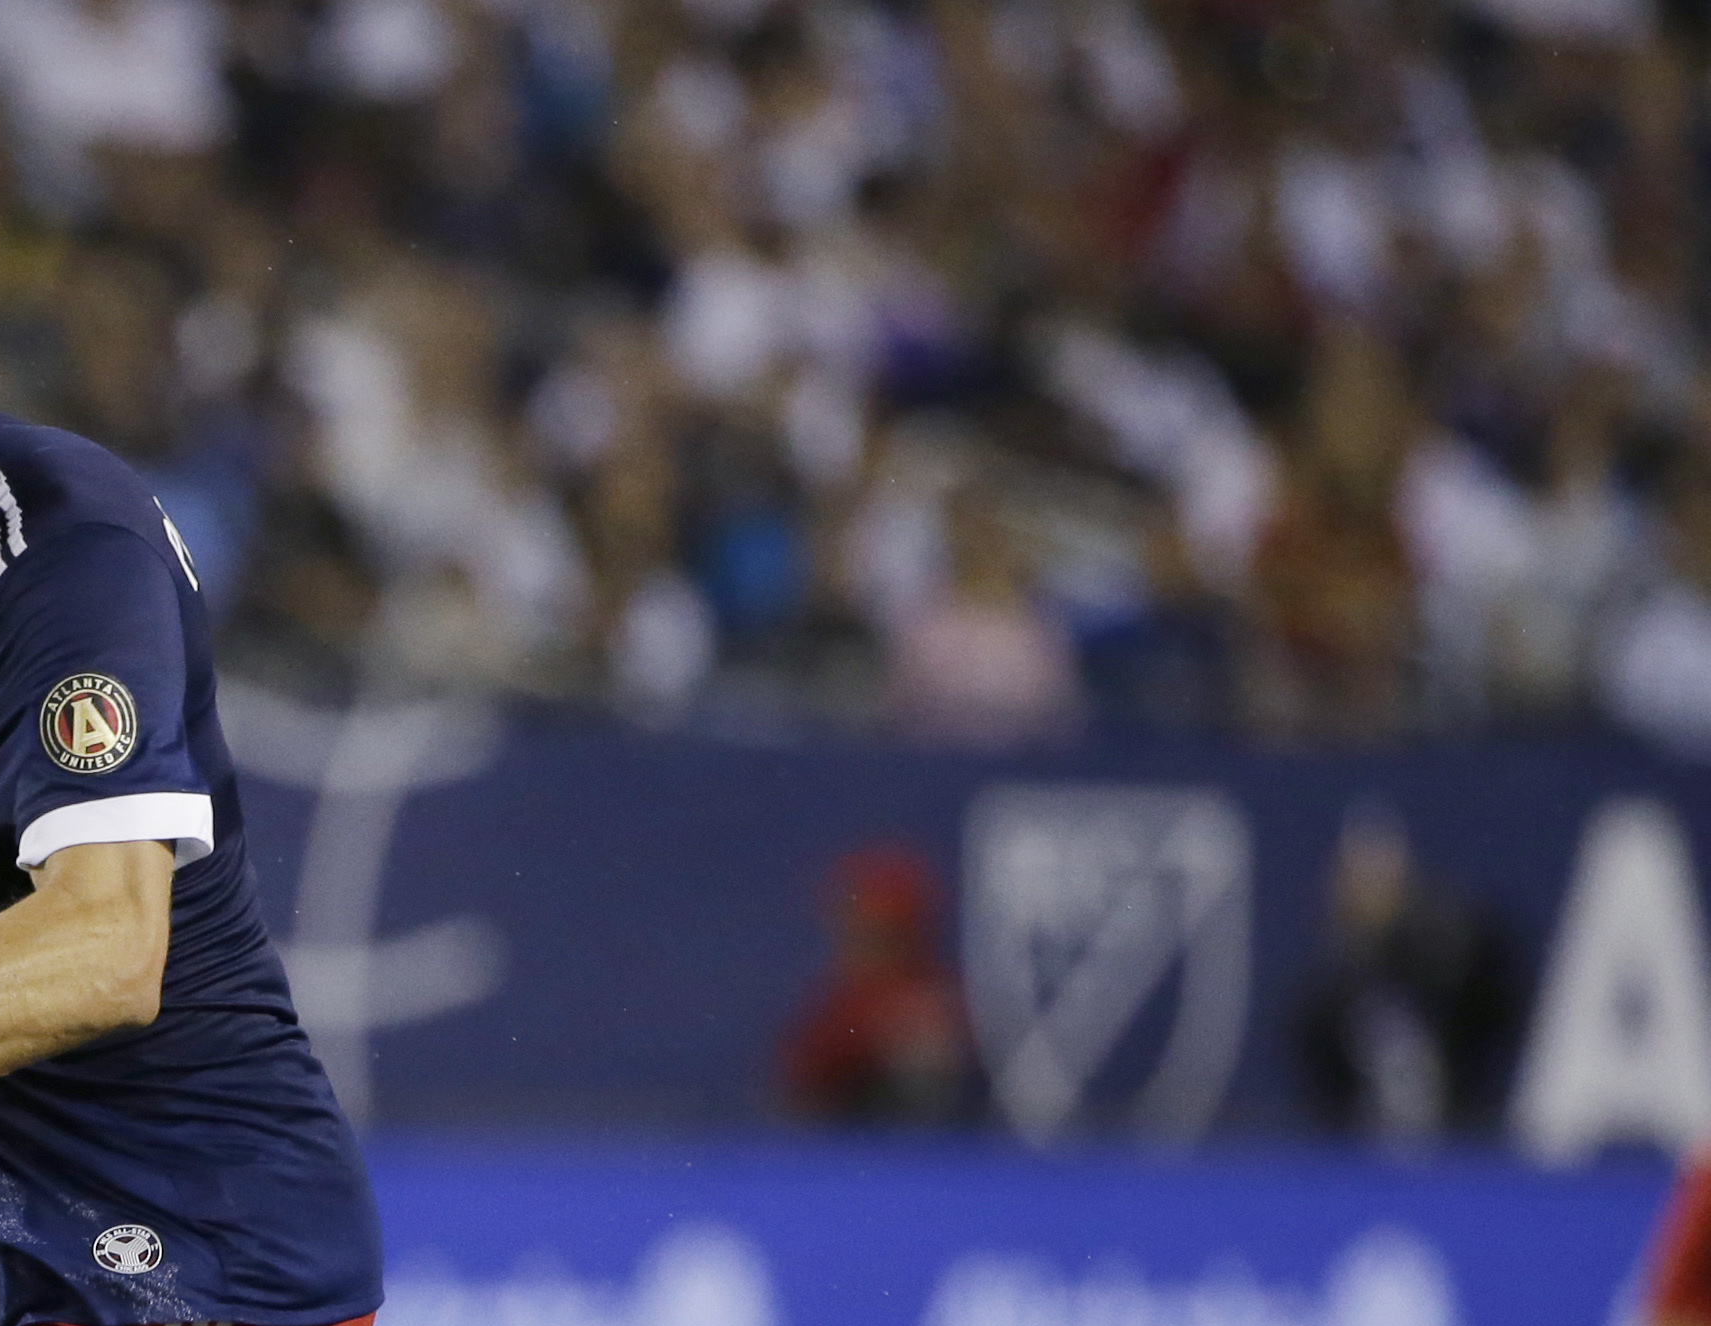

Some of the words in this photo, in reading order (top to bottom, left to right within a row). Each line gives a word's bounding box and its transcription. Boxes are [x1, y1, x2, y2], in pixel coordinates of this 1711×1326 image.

[48, 678, 113, 712] ATLANTA
[59, 751, 115, 769] UNITED
[115, 734, 131, 753] FC
